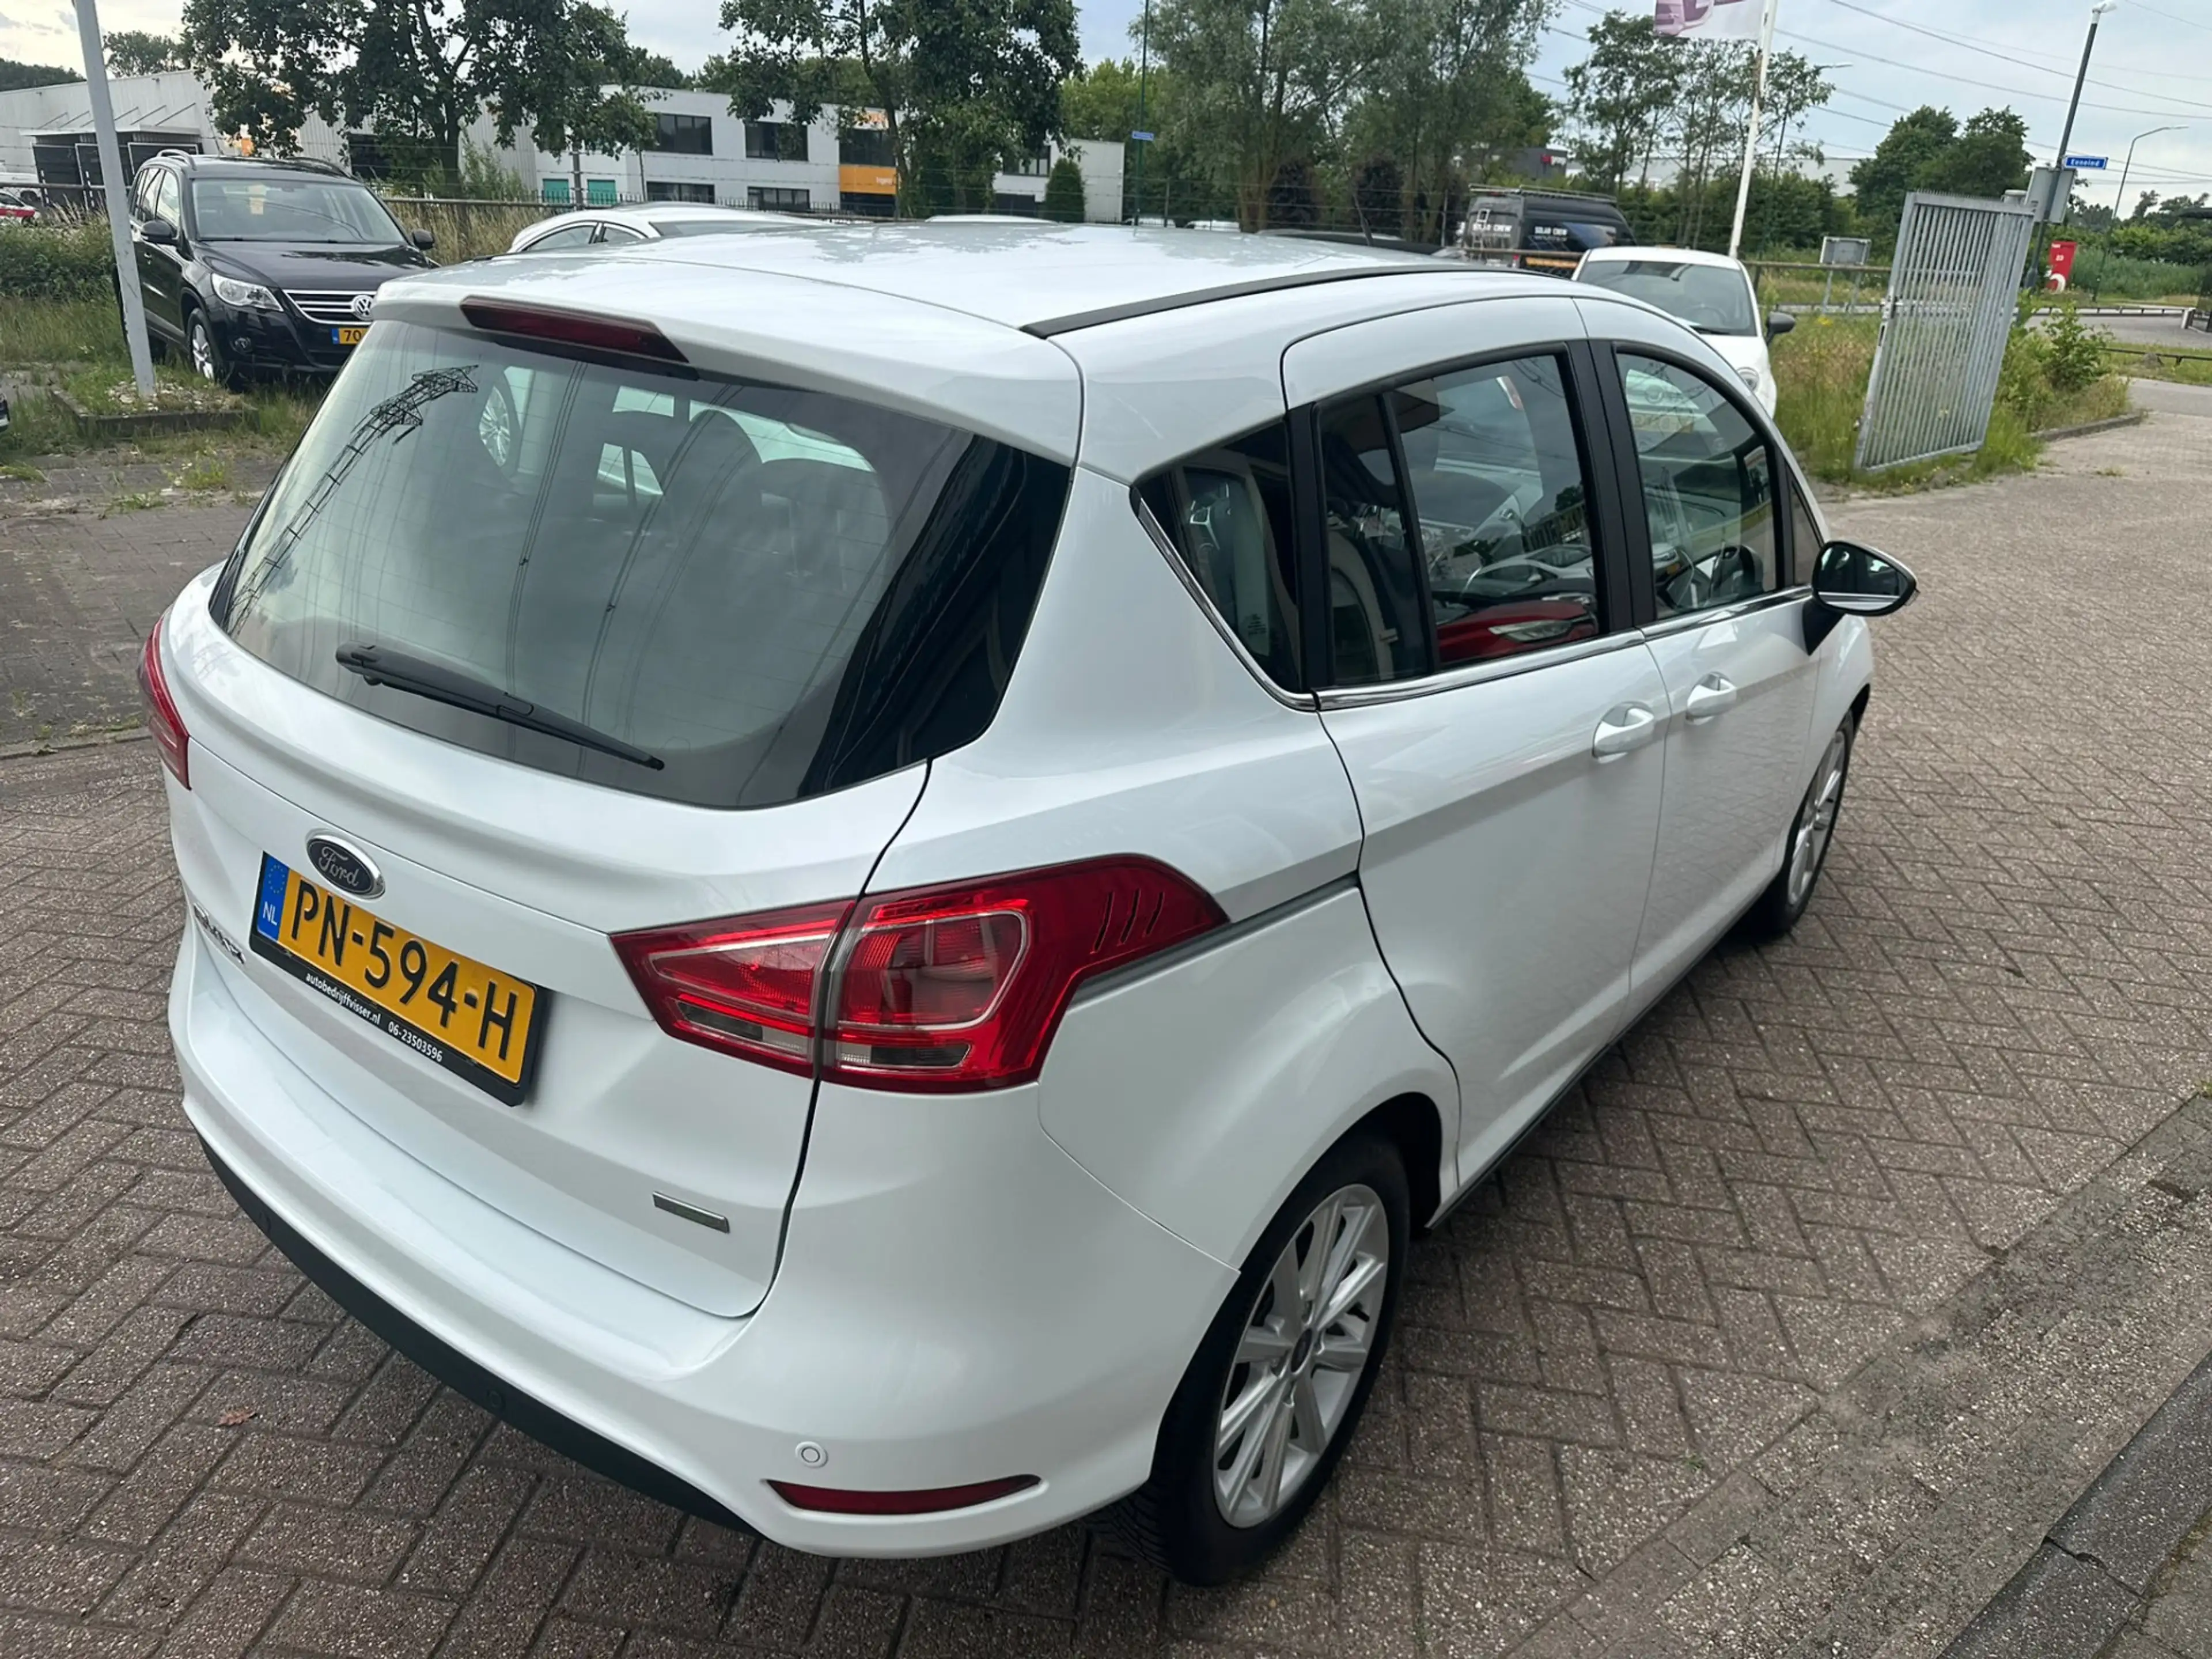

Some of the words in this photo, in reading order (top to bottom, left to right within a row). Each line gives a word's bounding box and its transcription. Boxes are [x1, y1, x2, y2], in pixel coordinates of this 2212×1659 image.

[318, 846, 360, 887] Ford
[262, 901, 278, 926] NL
[291, 879, 518, 1062] PN-594-H
[388, 1021, 443, 1062] 06-23503596
